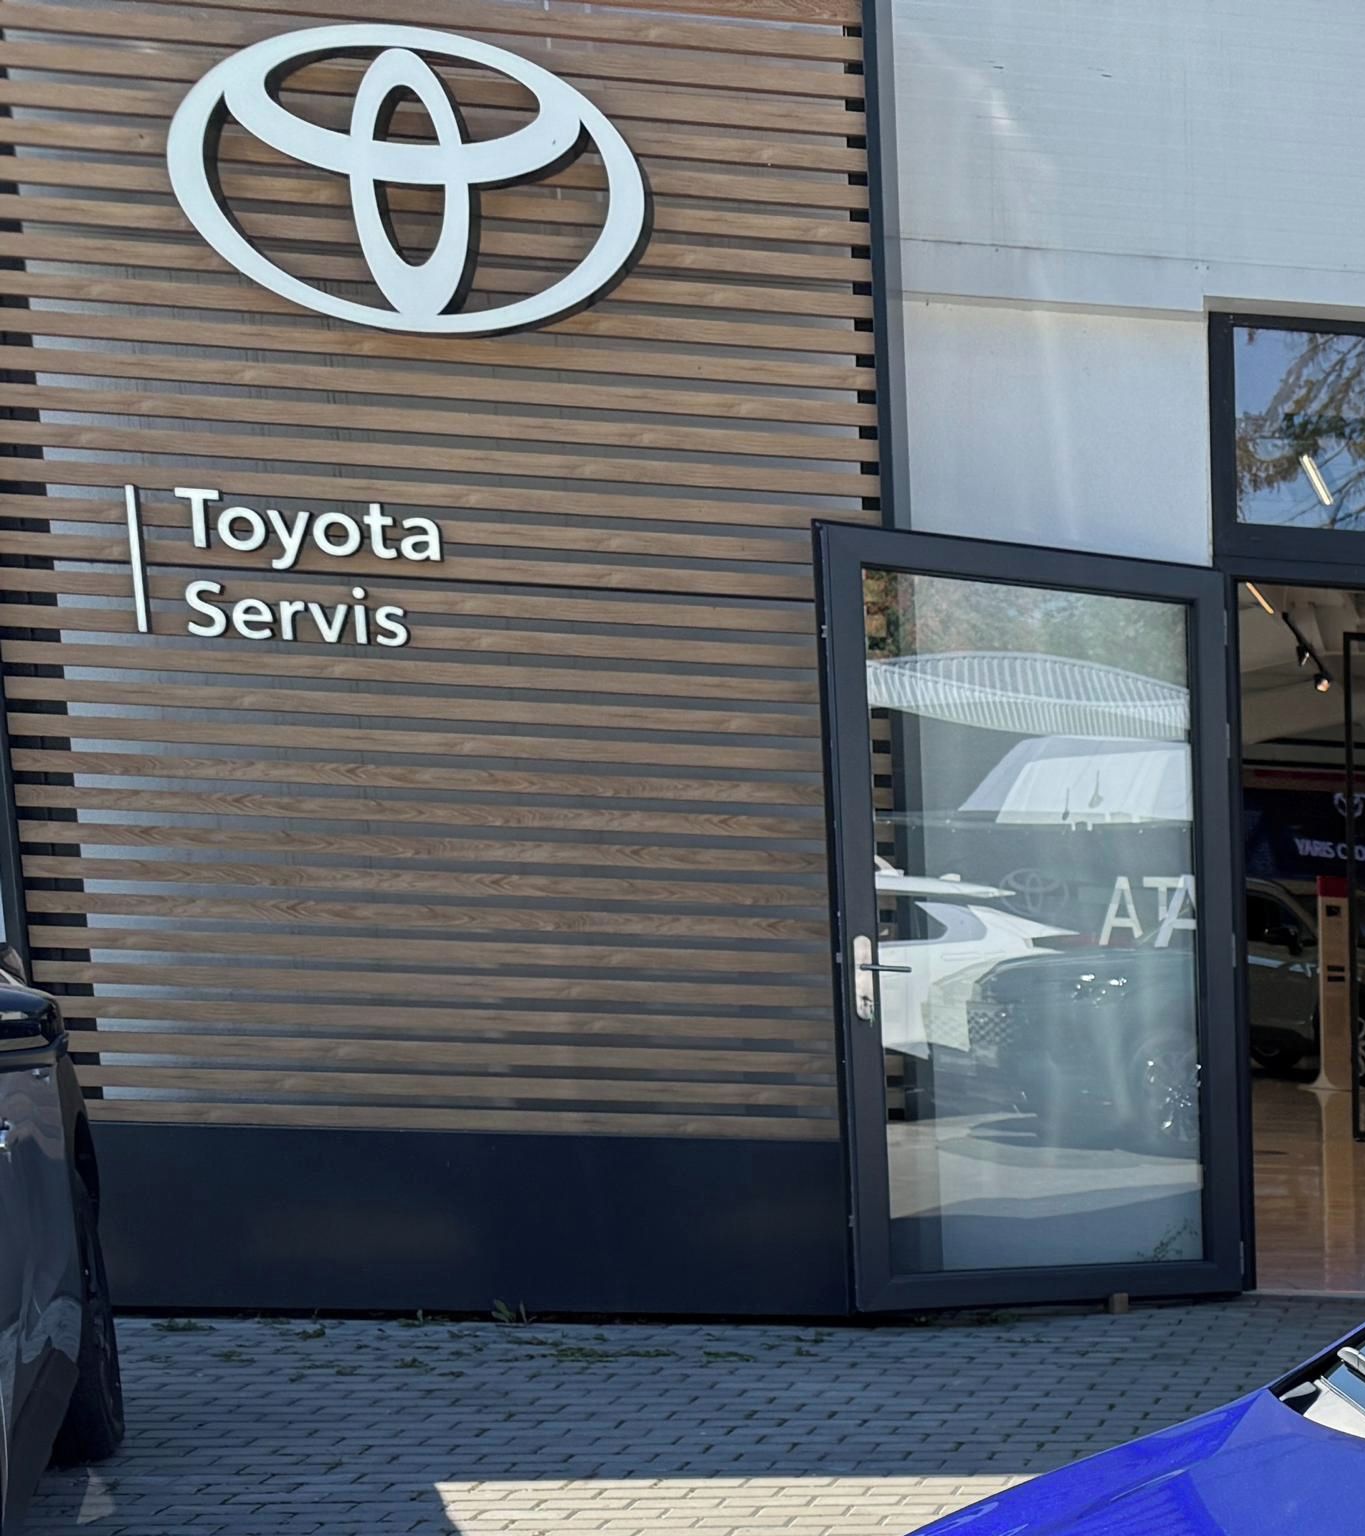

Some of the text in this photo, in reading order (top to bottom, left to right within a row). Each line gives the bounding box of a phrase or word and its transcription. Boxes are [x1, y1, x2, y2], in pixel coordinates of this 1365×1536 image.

[174, 487, 442, 570] Toyota
[185, 580, 409, 647] Servis
[1293, 837, 1336, 859] YARIS
